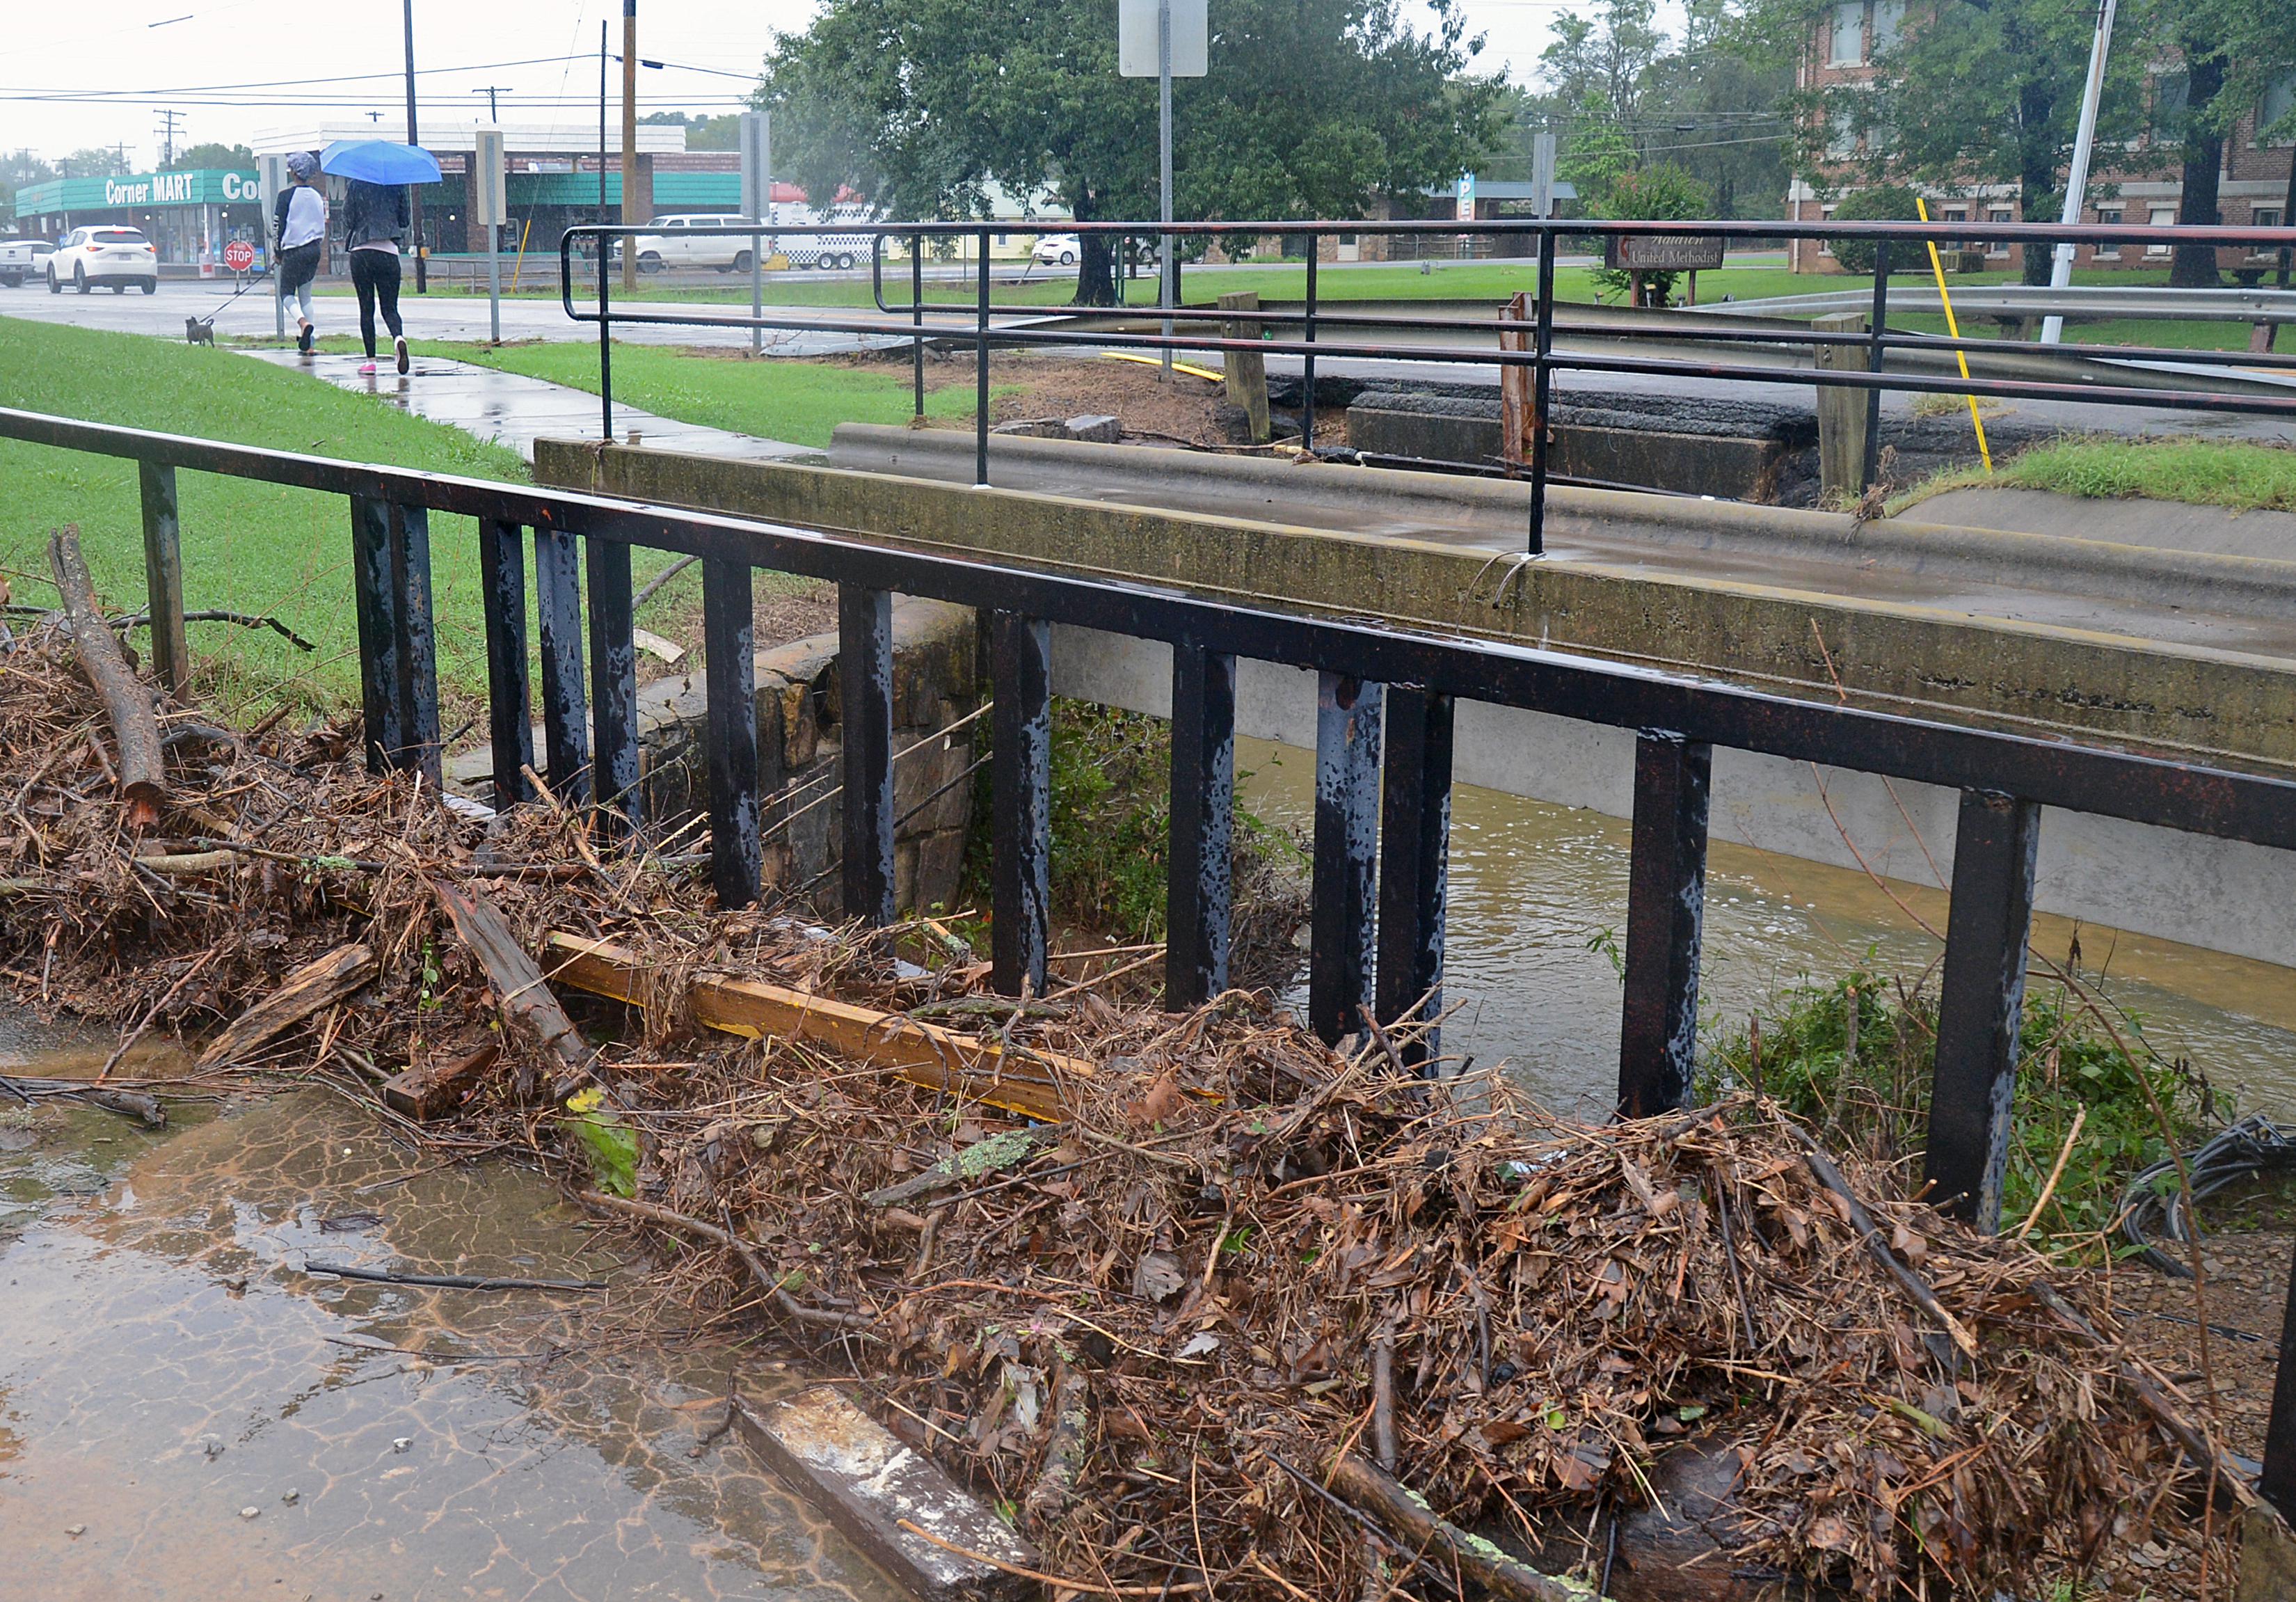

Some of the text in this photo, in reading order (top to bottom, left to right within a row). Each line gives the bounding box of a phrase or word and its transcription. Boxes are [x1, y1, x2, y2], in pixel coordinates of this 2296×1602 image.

[106, 173, 193, 205] Corner MART
[1460, 169, 1471, 221] PE
[226, 250, 251, 262] STOP
[1632, 251, 1718, 264] United Methodist
